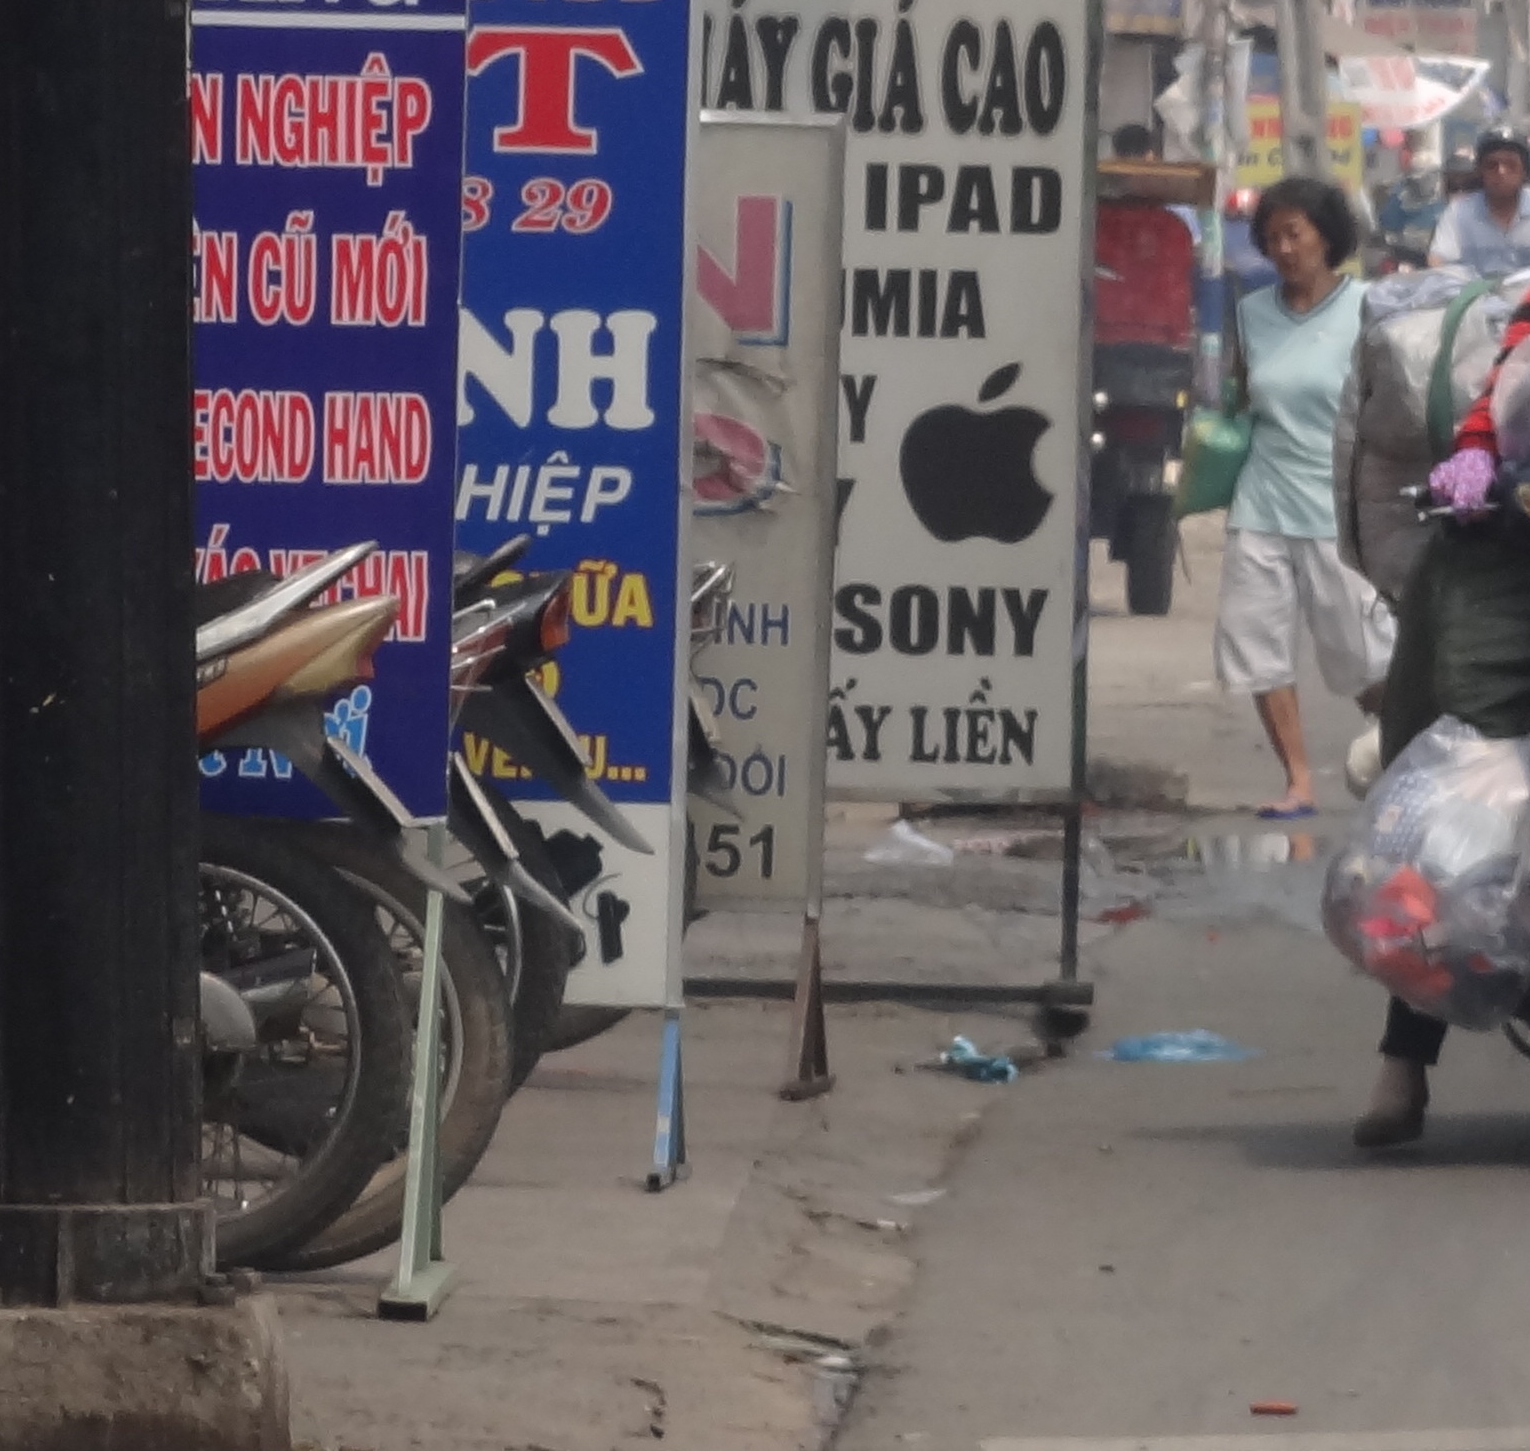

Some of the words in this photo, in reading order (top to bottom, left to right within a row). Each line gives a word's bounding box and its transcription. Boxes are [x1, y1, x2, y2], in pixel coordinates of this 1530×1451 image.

[237, 52, 433, 187] NGHIỆP
[940, 18, 1066, 138] CAO
[511, 177, 613, 234] 29
[864, 161, 1064, 235] IPAD
[248, 210, 317, 327] CŨ
[330, 210, 429, 328] MỚI
[841, 267, 986, 340] MIA
[323, 390, 433, 486] HAND
[457, 452, 631, 536] HIỆP
[835, 583, 1049, 657] SONY
